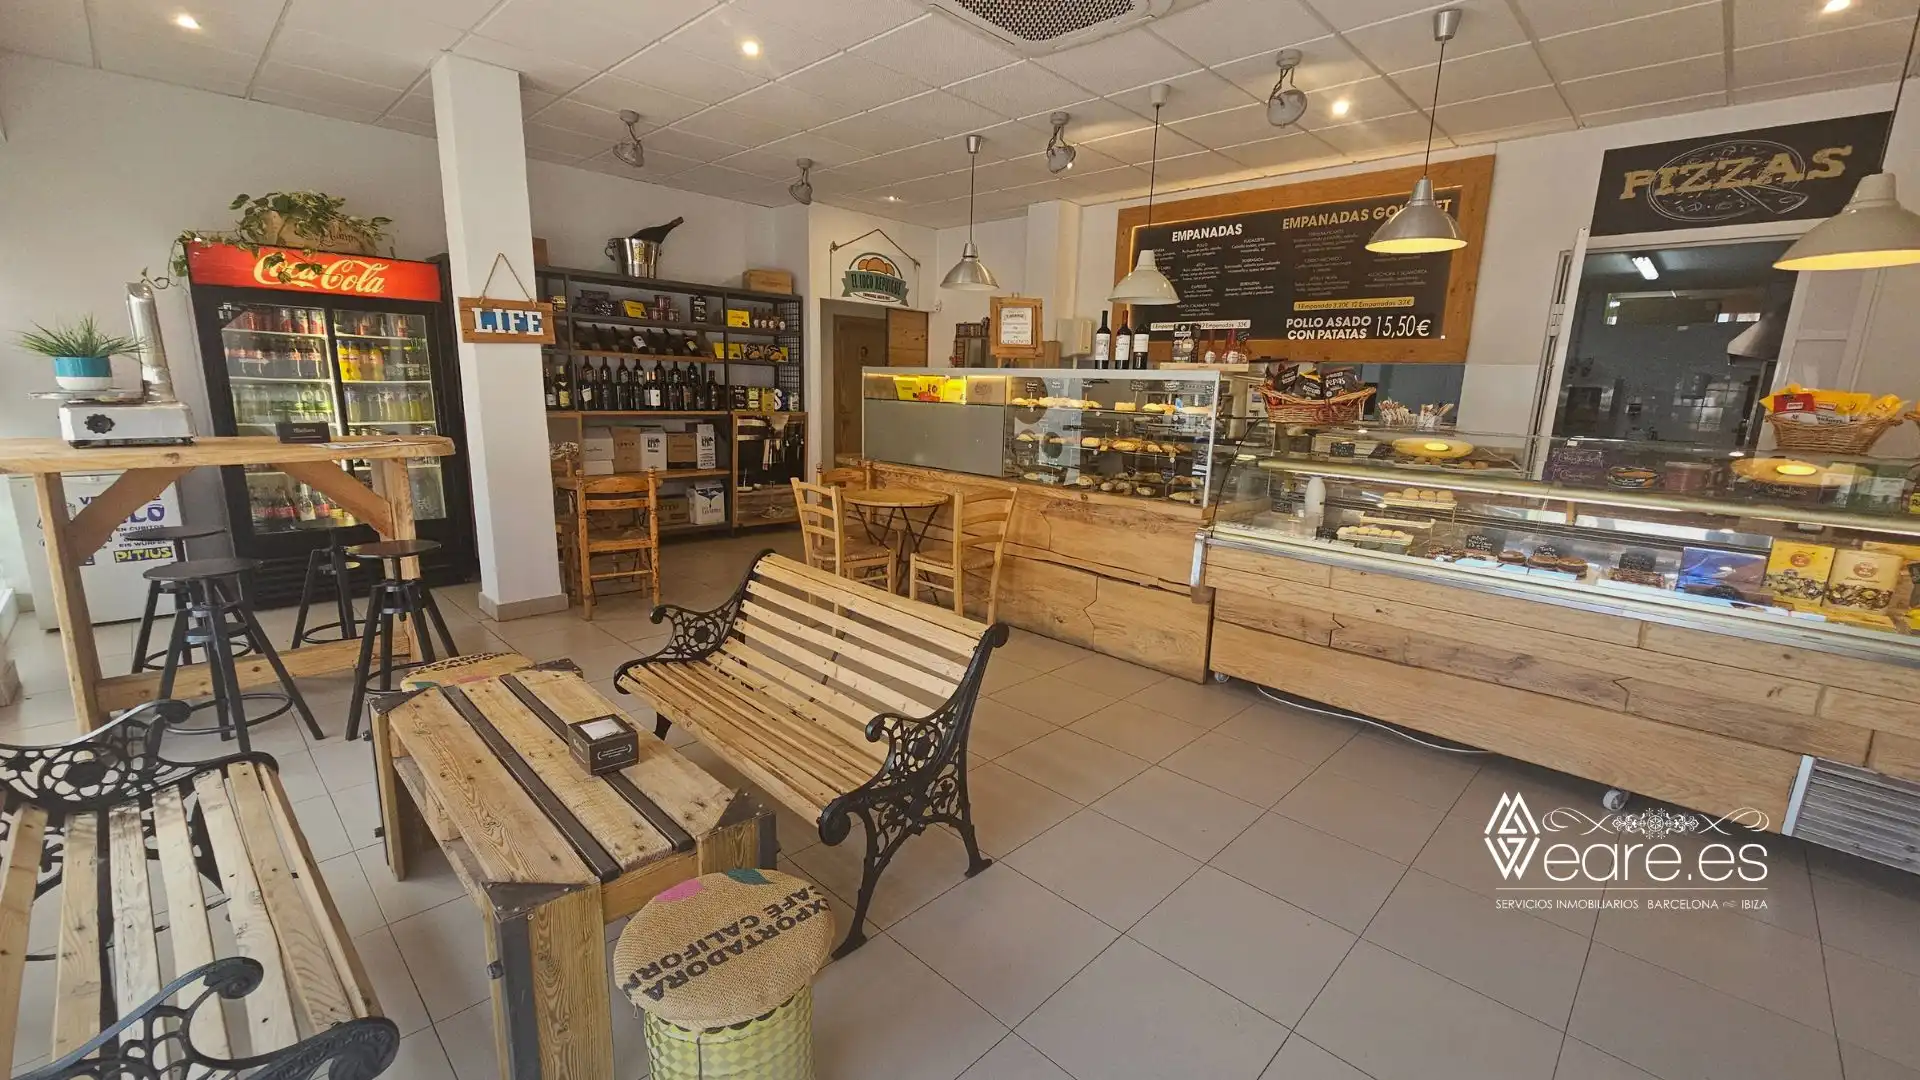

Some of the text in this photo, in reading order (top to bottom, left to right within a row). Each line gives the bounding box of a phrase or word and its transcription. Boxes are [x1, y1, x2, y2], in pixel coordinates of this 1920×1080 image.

[1619, 145, 1853, 200] PIZZAS
[1282, 199, 1452, 231] EMPANADAS GOET
[1172, 223, 1243, 243] EMPANADAS
[471, 308, 544, 336] LIFE
[1286, 316, 1371, 328] POLLO ASADO
[1376, 315, 1432, 339] 15,50€
[1288, 328, 1367, 340] CON PATATAS
[115, 547, 172, 563] PITIUS
